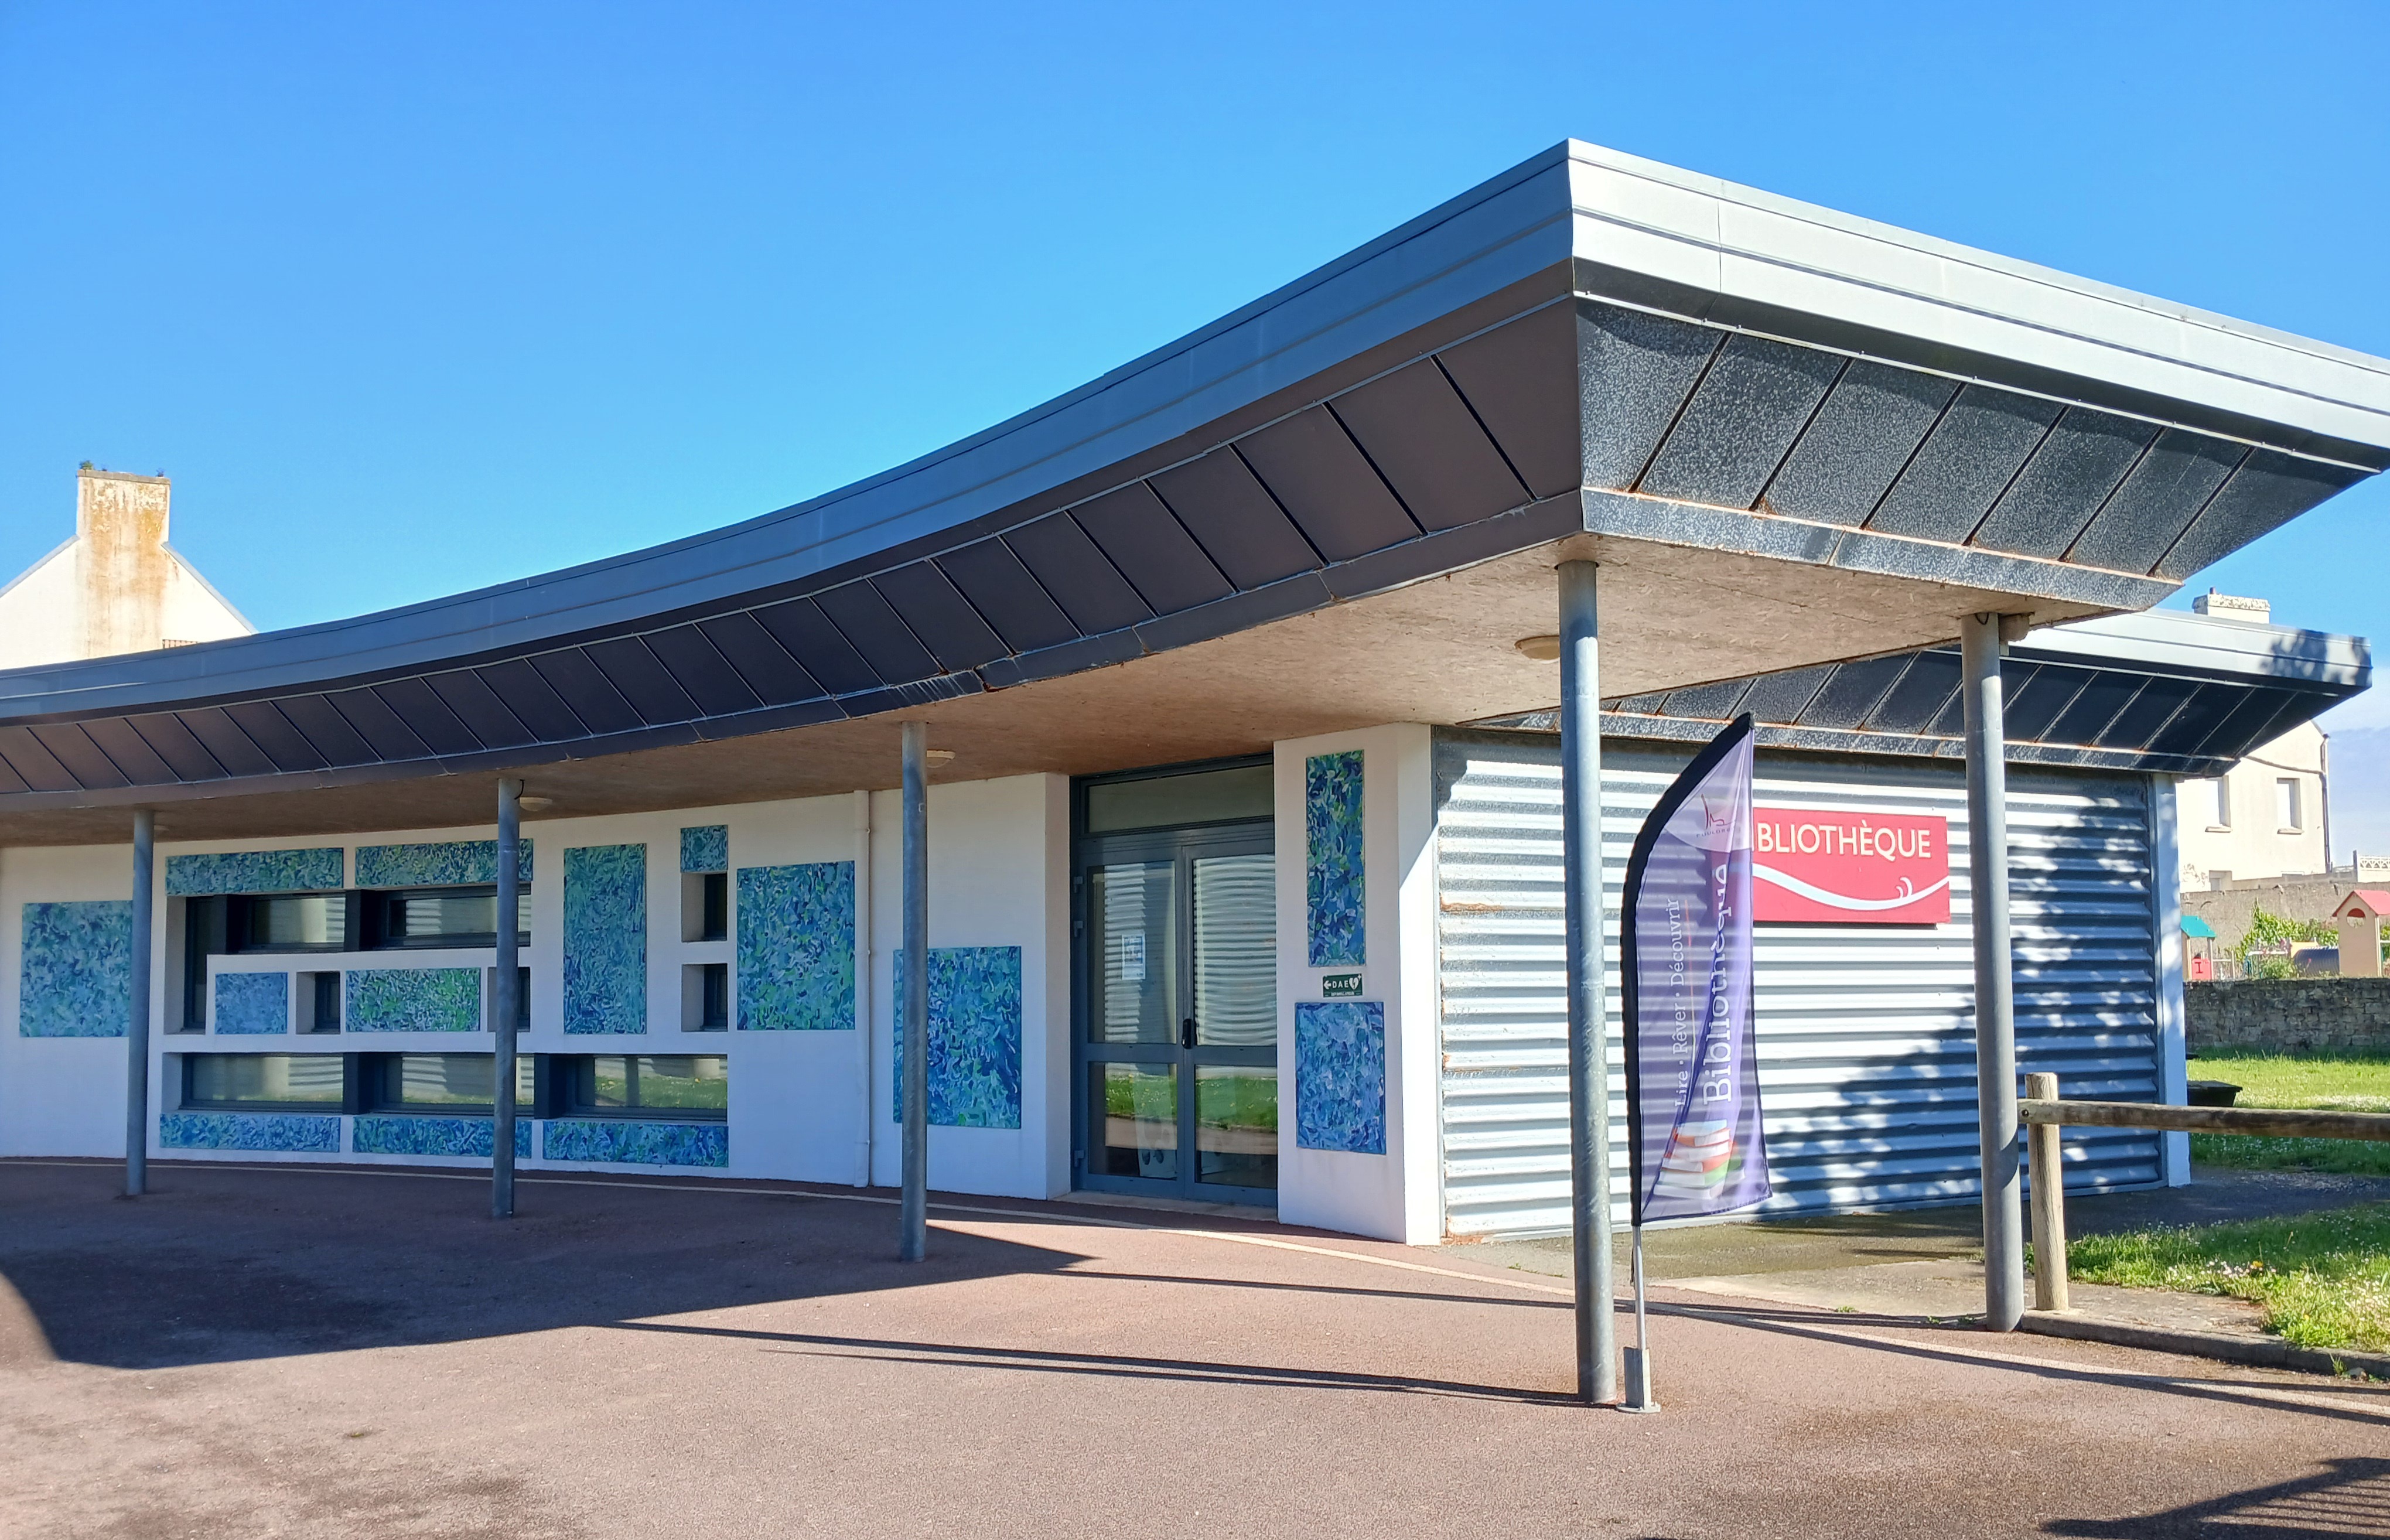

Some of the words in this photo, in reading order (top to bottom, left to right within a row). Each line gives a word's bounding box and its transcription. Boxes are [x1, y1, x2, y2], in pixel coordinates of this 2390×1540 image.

[1751, 819, 1931, 861] BLIOTHÈQUE
[1665, 899, 1684, 986] Découvrir
[1332, 980, 1349, 988] DAE
[1672, 1003, 1688, 1054] Rêver
[1675, 1071, 1688, 1107] Lire
